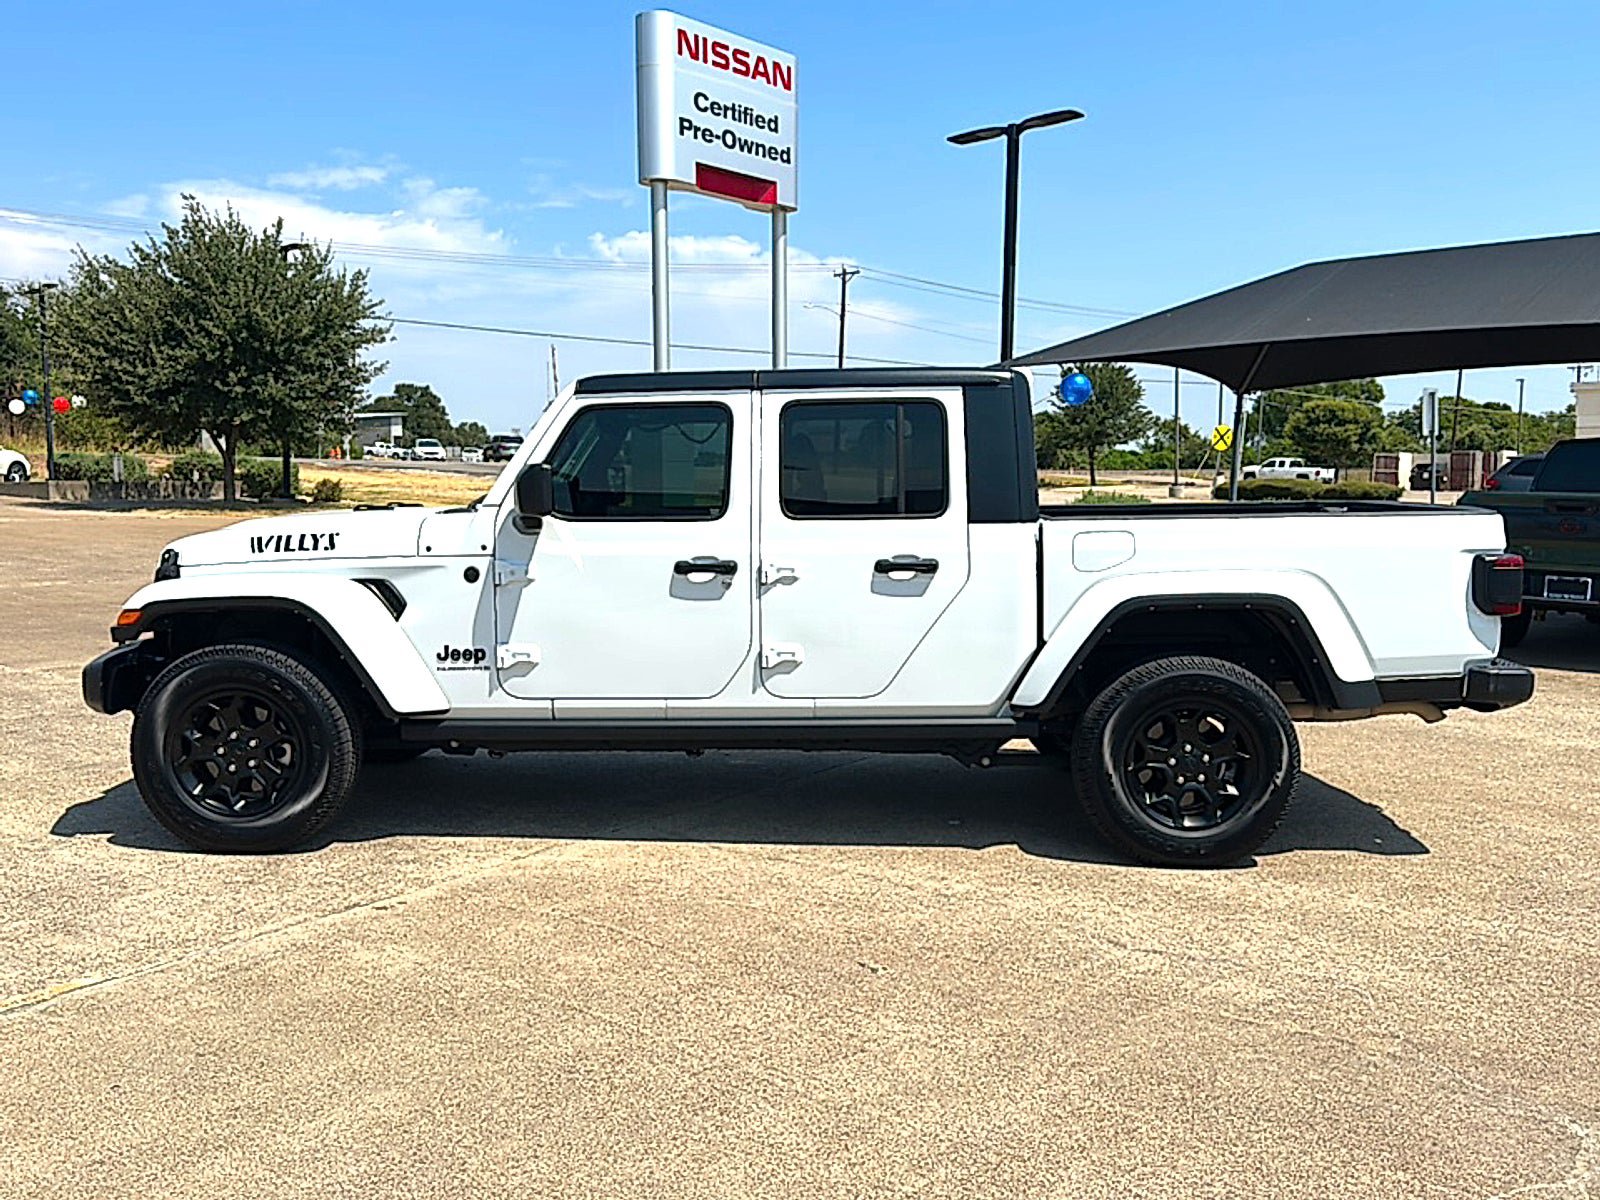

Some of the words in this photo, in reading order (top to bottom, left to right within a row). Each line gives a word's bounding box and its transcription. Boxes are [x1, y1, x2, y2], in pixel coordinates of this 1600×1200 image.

[677, 28, 792, 91] NISSAN
[693, 92, 779, 133] Certified
[679, 117, 791, 164] Pre-Owned
[250, 532, 340, 553] WILLYS
[436, 644, 486, 664] Jeep
